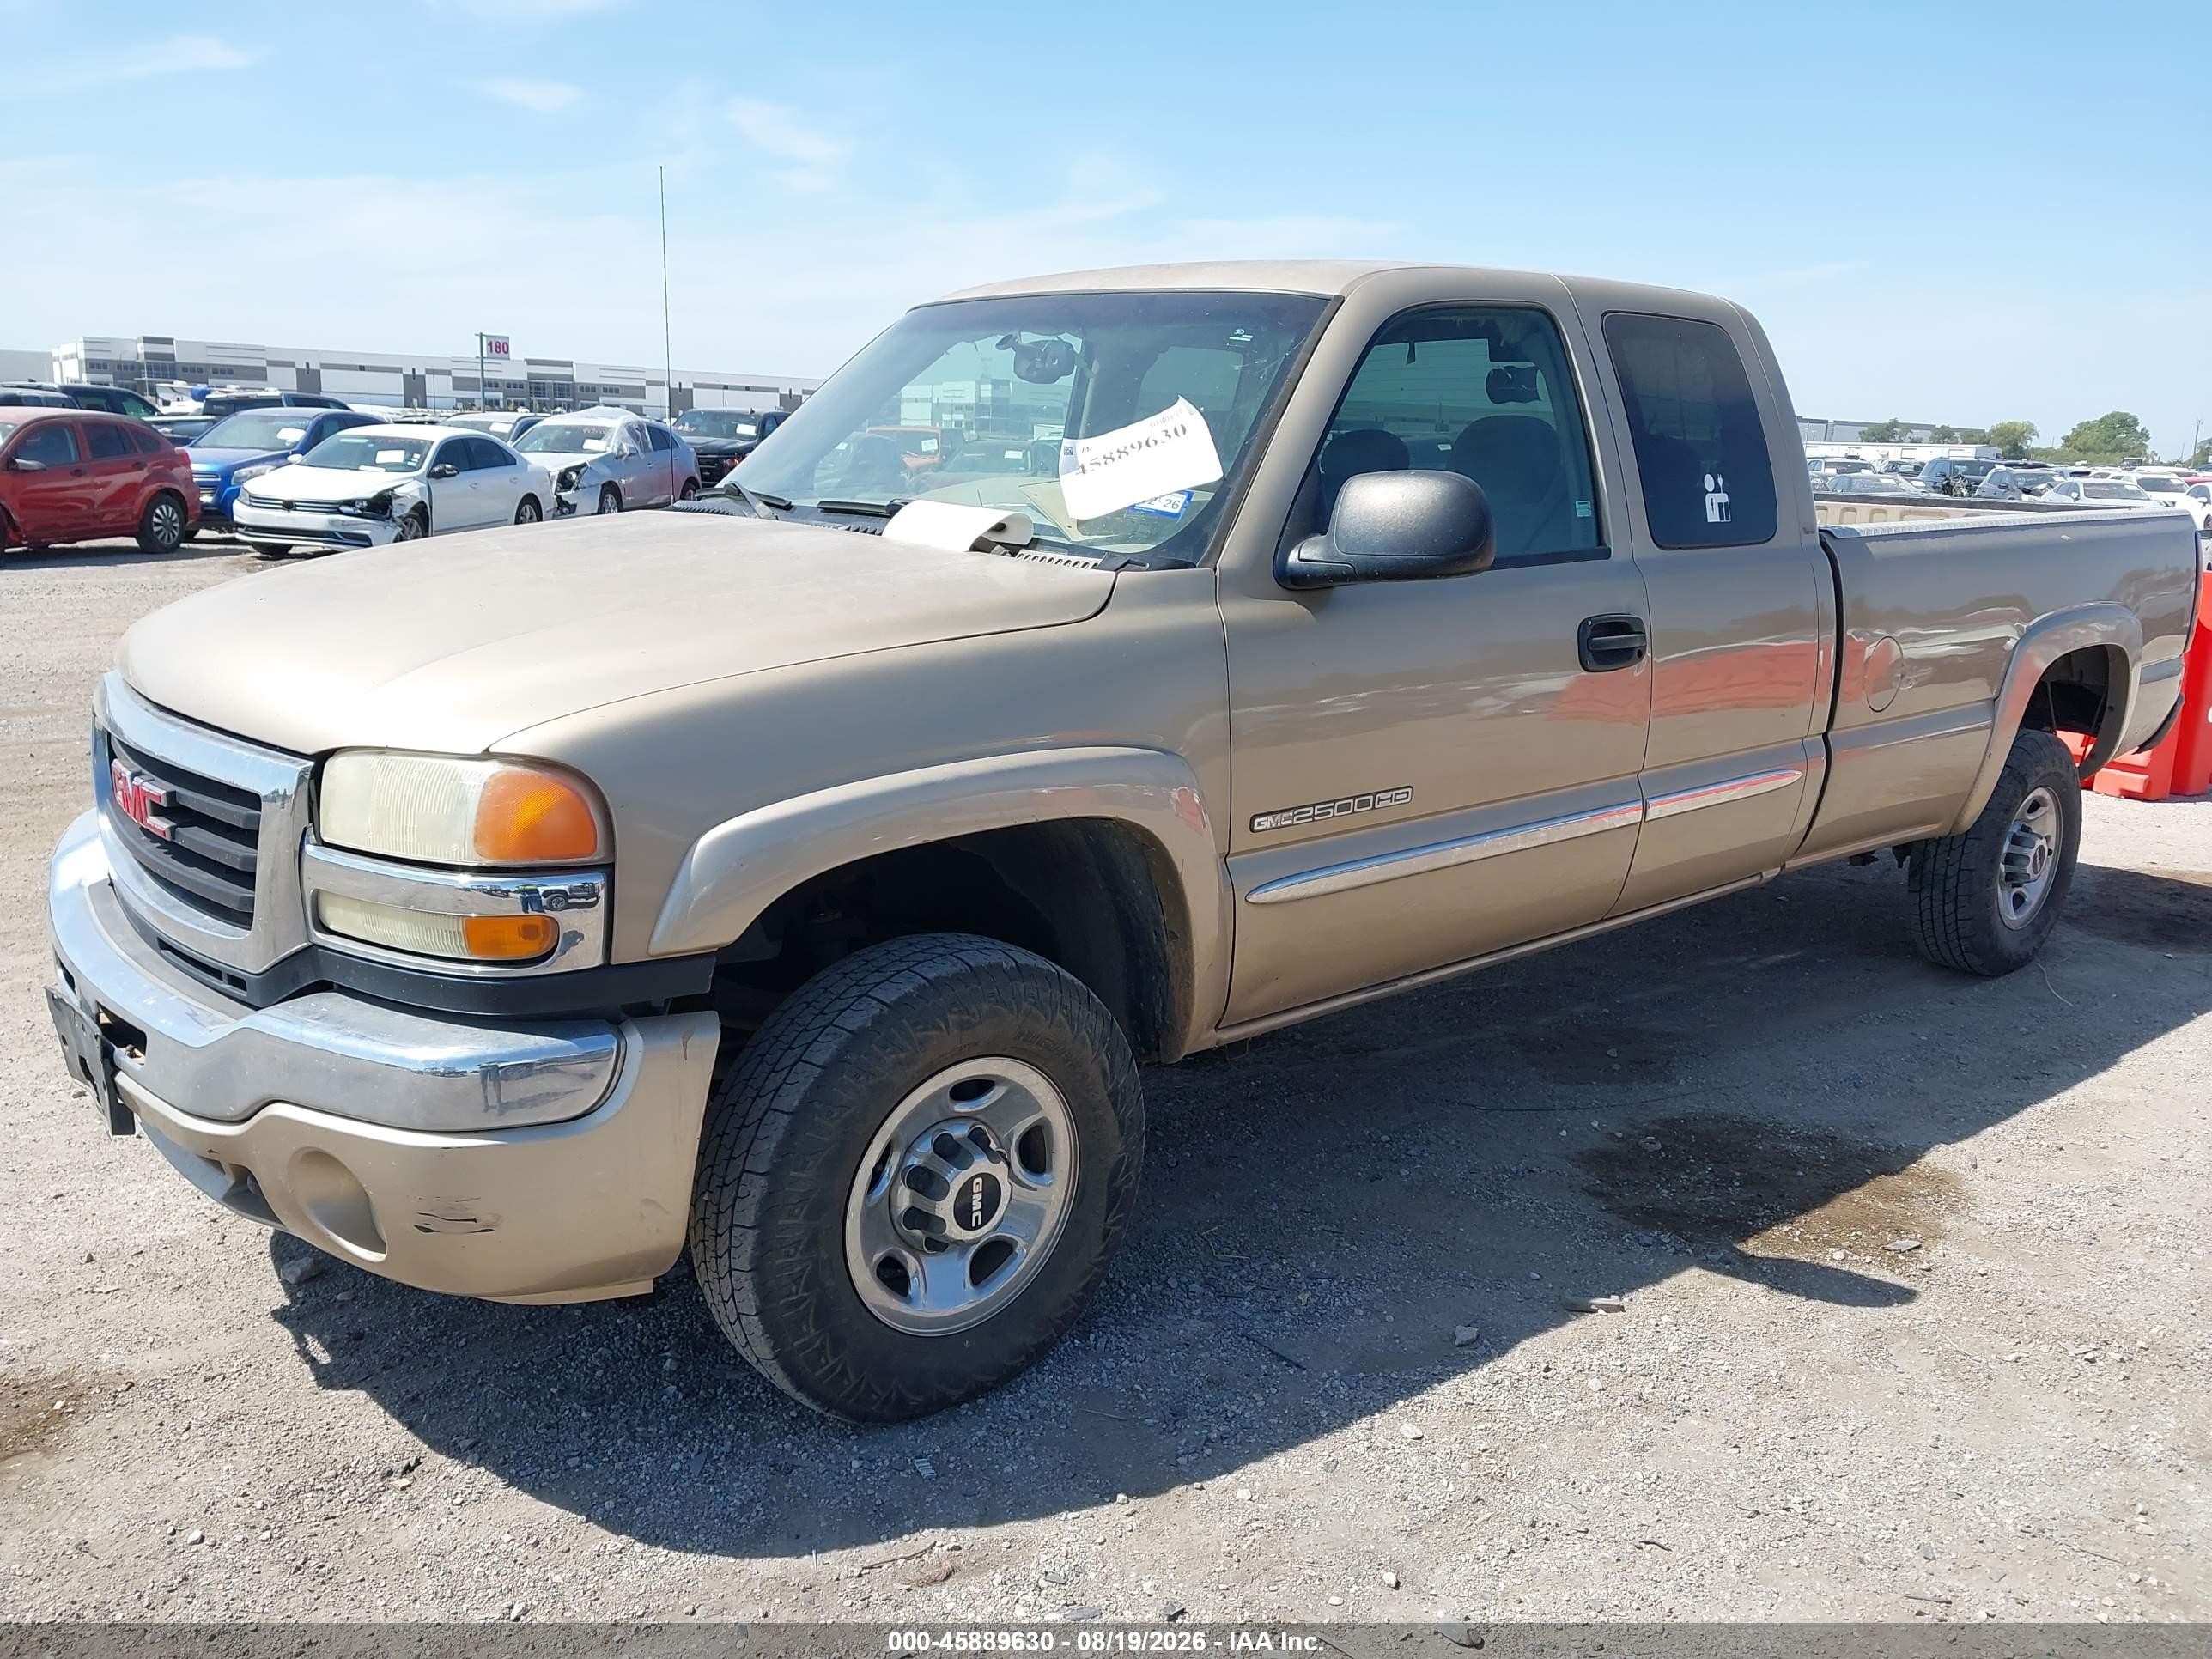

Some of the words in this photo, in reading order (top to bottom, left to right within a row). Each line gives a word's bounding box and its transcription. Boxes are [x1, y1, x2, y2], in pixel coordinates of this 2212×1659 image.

[487, 341, 509, 354] 180
[1164, 498, 1181, 510] 26
[112, 758, 172, 841] GMC
[972, 1177, 983, 1227] GMC
